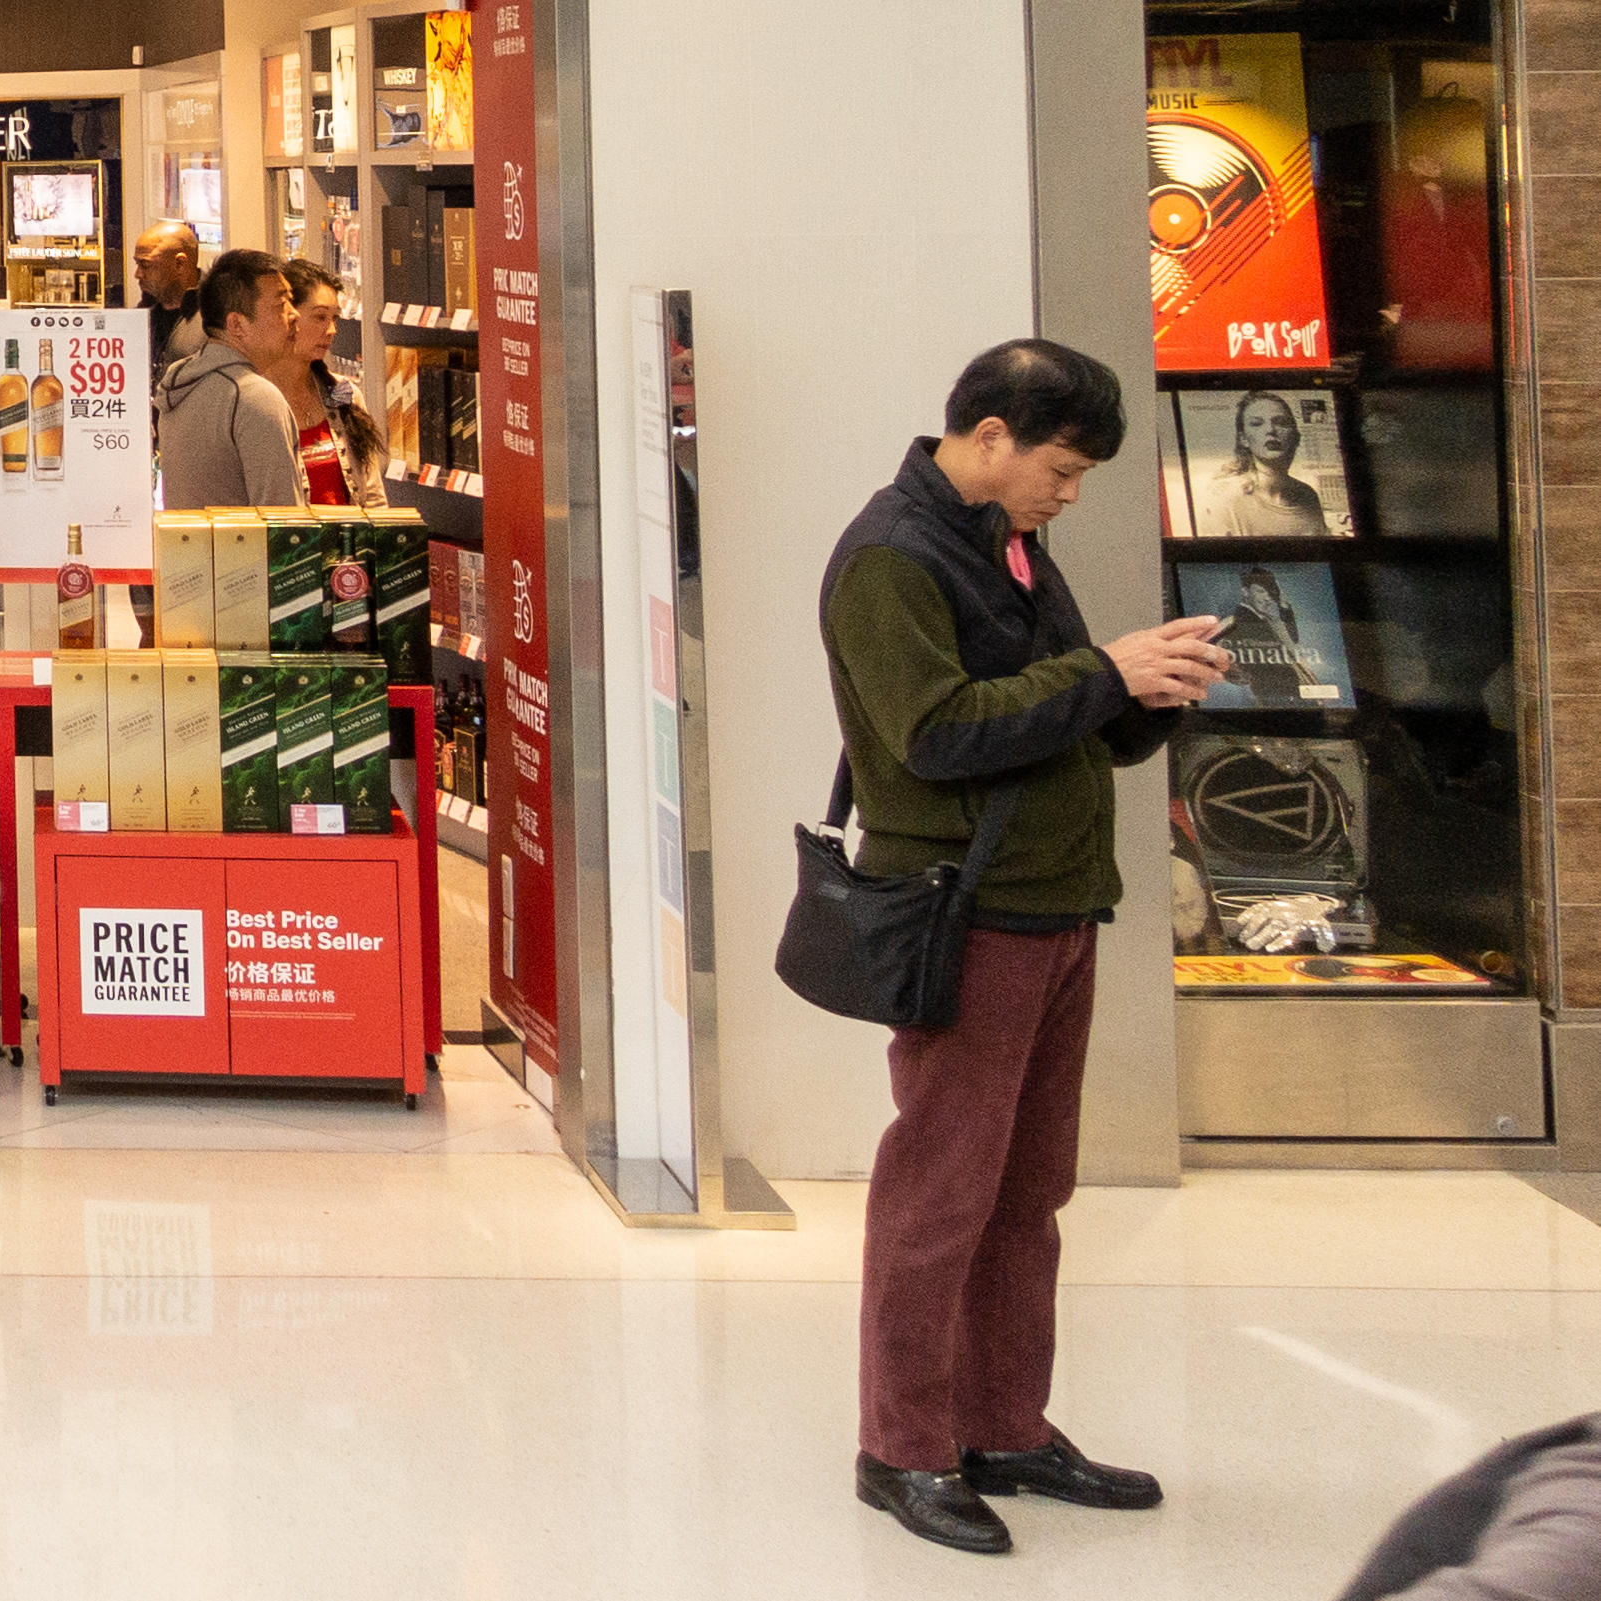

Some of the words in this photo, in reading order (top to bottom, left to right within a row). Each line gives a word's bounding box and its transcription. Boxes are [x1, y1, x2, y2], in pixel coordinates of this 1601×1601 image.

[509, 270, 538, 297] MATCH
[69, 337, 81, 359] 2
[87, 337, 125, 359] FOR
[69, 361, 126, 397] $99
[70, 398, 127, 419] 買2件
[93, 433, 130, 451] $60
[518, 669, 548, 708] MATCH
[248, 711, 270, 724] GREEN
[304, 711, 326, 725] GREEN
[360, 711, 382, 725] GREEN
[226, 909, 275, 928] Best
[281, 910, 339, 929] Price
[92, 922, 189, 954] PRICE
[226, 930, 255, 948] On
[261, 930, 312, 949] Best
[317, 931, 384, 951] Seller
[93, 955, 190, 984] MATCH
[225, 961, 316, 984] 价格保证
[94, 985, 191, 1002] GUARANTEE
